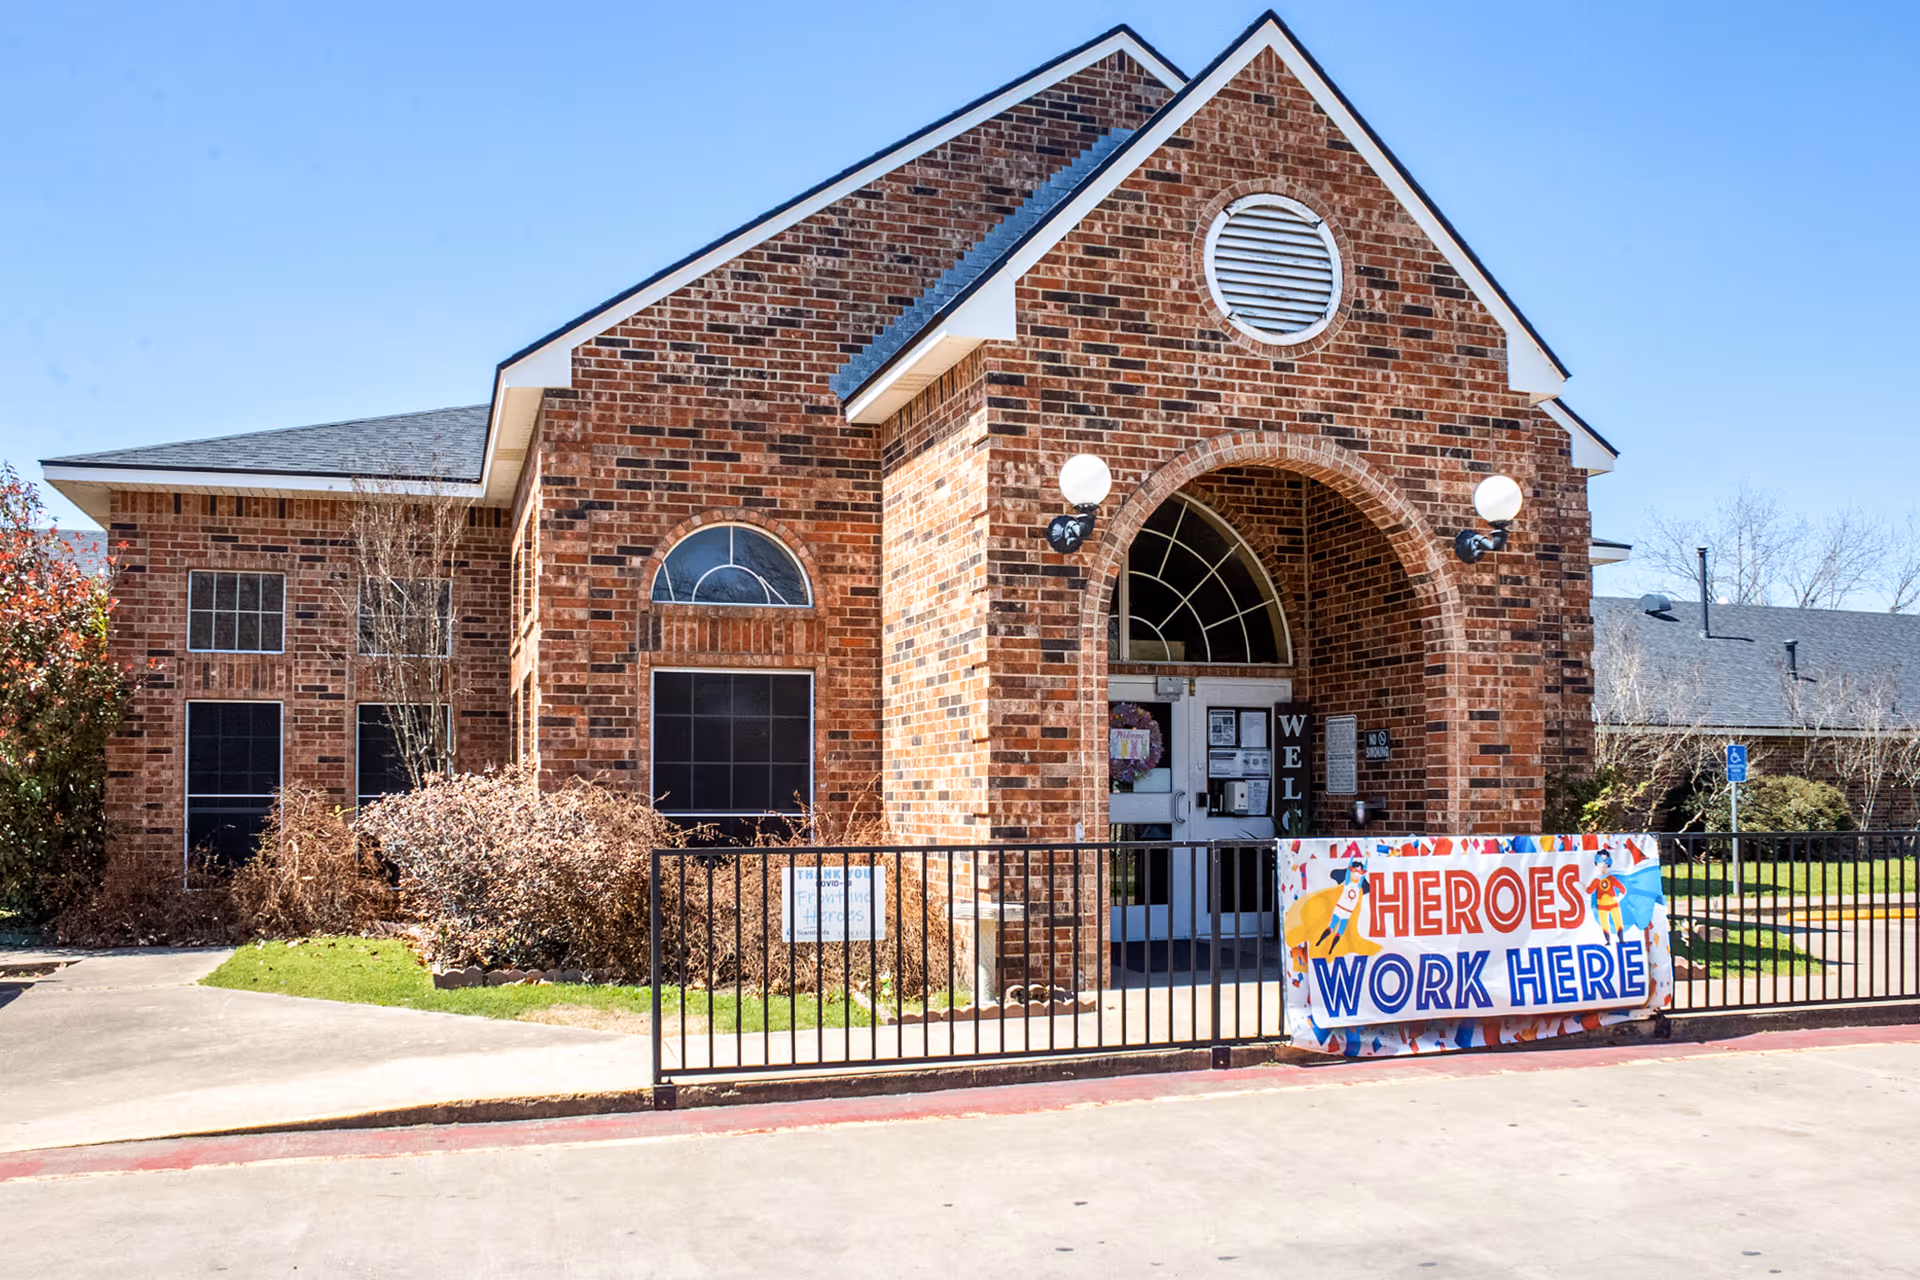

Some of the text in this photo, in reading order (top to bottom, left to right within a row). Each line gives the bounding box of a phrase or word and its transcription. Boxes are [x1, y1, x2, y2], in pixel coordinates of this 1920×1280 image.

[796, 869, 842, 880] THNK
[1368, 864, 1586, 937] HEROES
[1312, 940, 1646, 1018] WORK HERE
